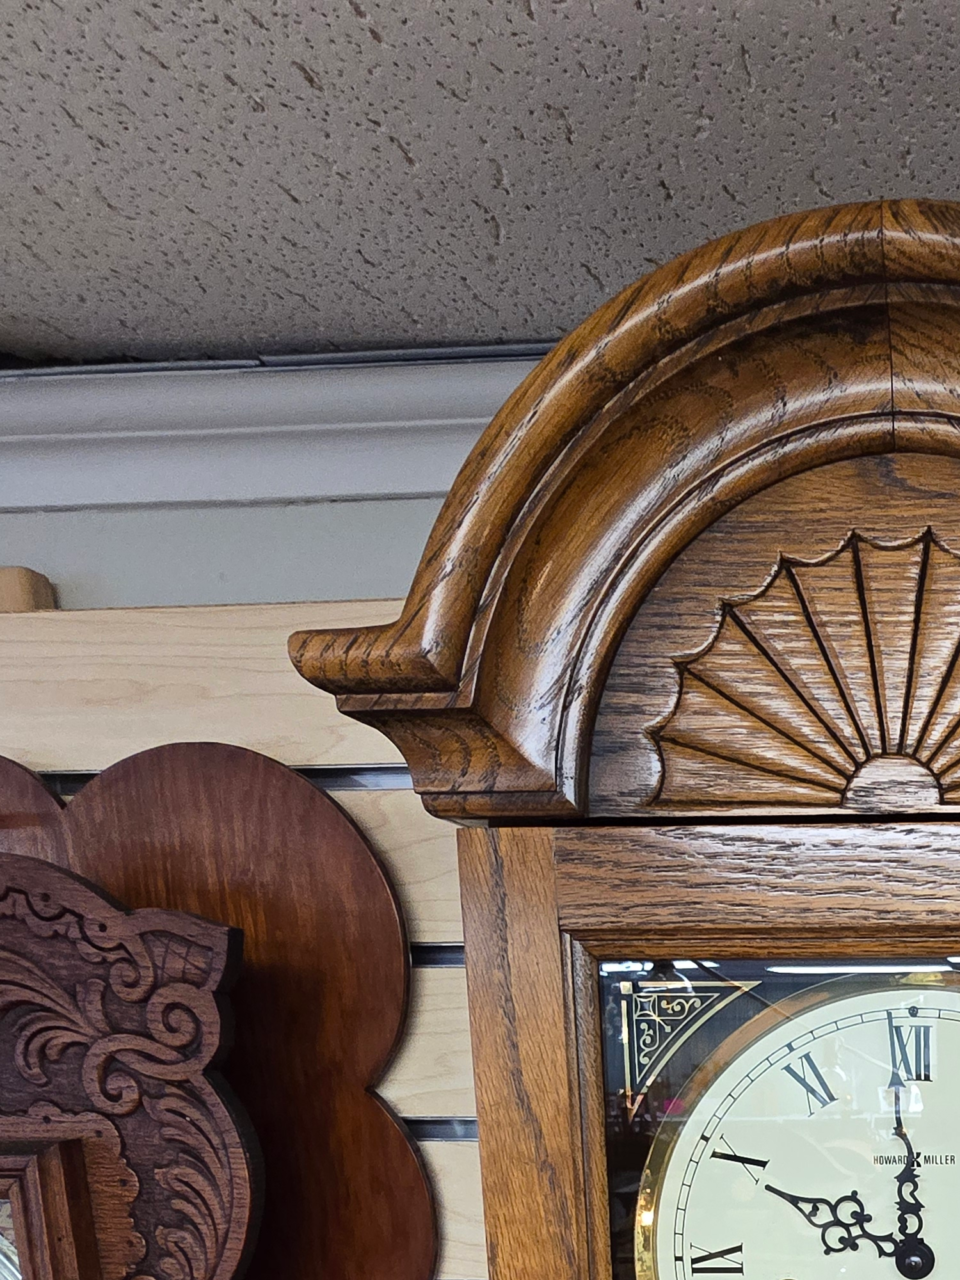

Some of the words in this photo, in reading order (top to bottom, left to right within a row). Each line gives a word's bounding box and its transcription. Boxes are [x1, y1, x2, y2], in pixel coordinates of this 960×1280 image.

[892, 1025, 933, 1082] XII
[781, 1051, 839, 1118] XI
[709, 1133, 770, 1185] X
[873, 1155, 909, 1166] HOWARD
[923, 1155, 956, 1166] MILLER
